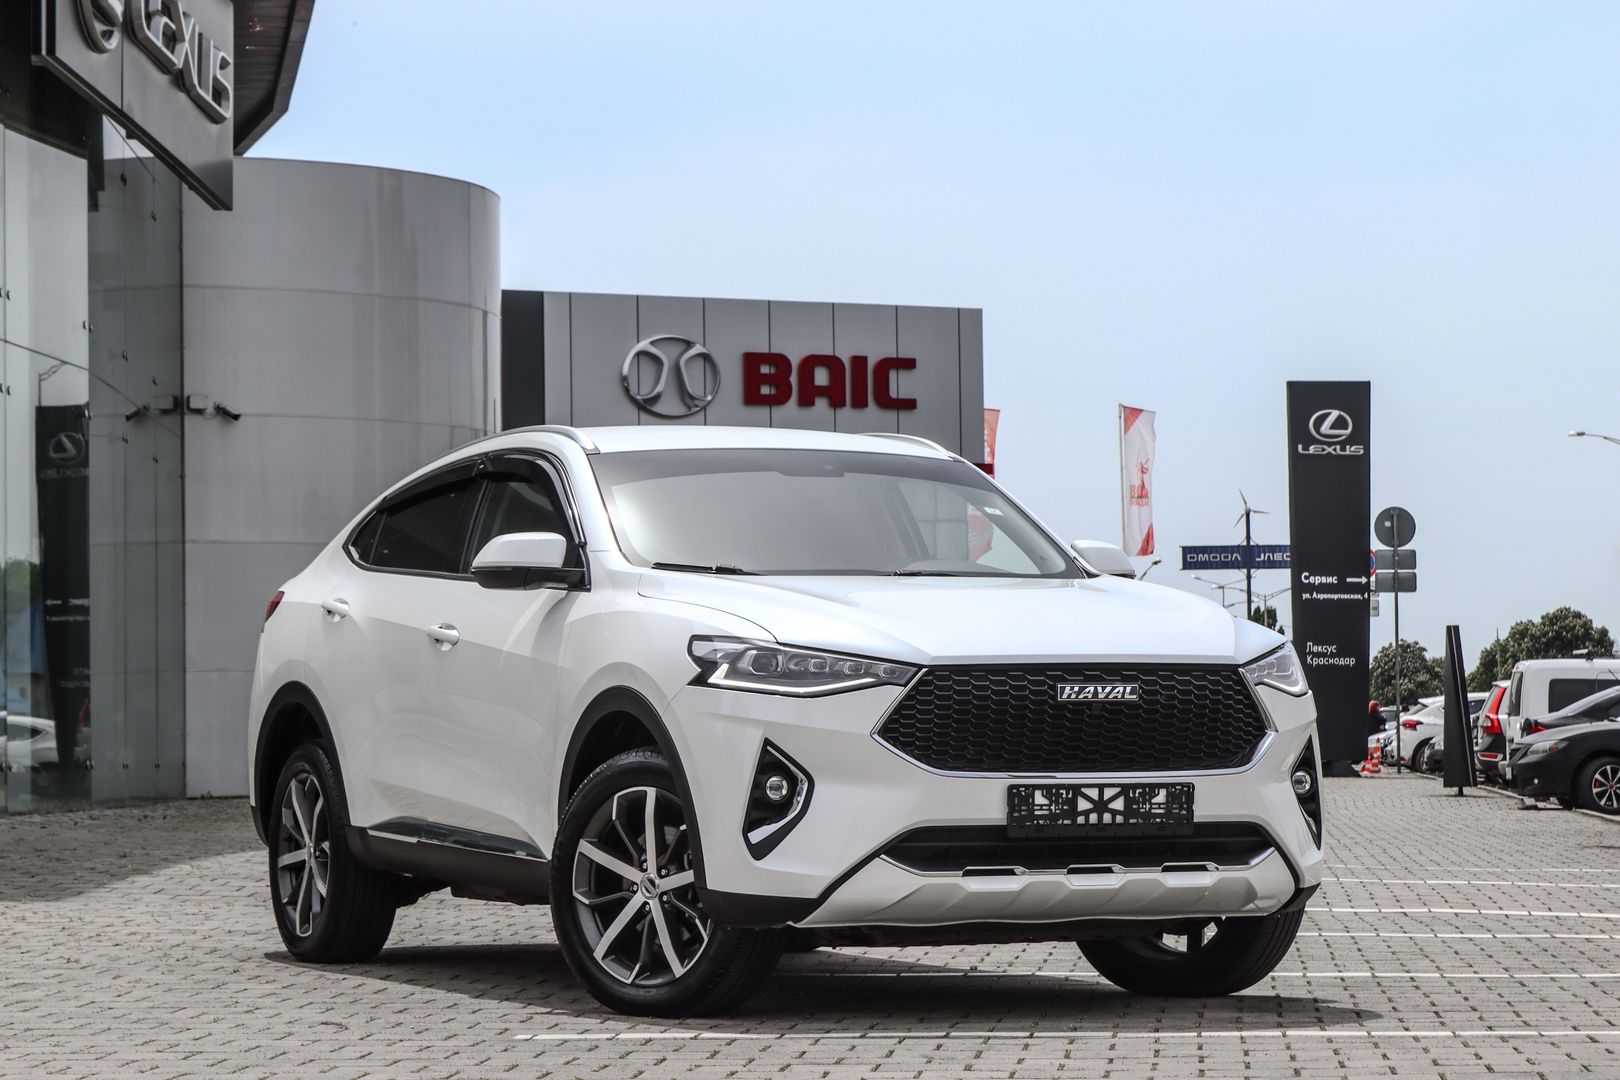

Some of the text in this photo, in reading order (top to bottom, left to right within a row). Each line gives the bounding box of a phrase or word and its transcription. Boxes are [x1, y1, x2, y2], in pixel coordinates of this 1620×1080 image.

[743, 352, 917, 410] BAIC
[1297, 444, 1364, 455] LEXUS
[1186, 553, 1241, 562] OMODA
[1301, 572, 1338, 586] Сервис
[1302, 592, 1311, 600] ул.
[1306, 641, 1337, 655] Лексус
[1306, 654, 1356, 667] Краснодар
[1061, 686, 1137, 699] HAVAL
